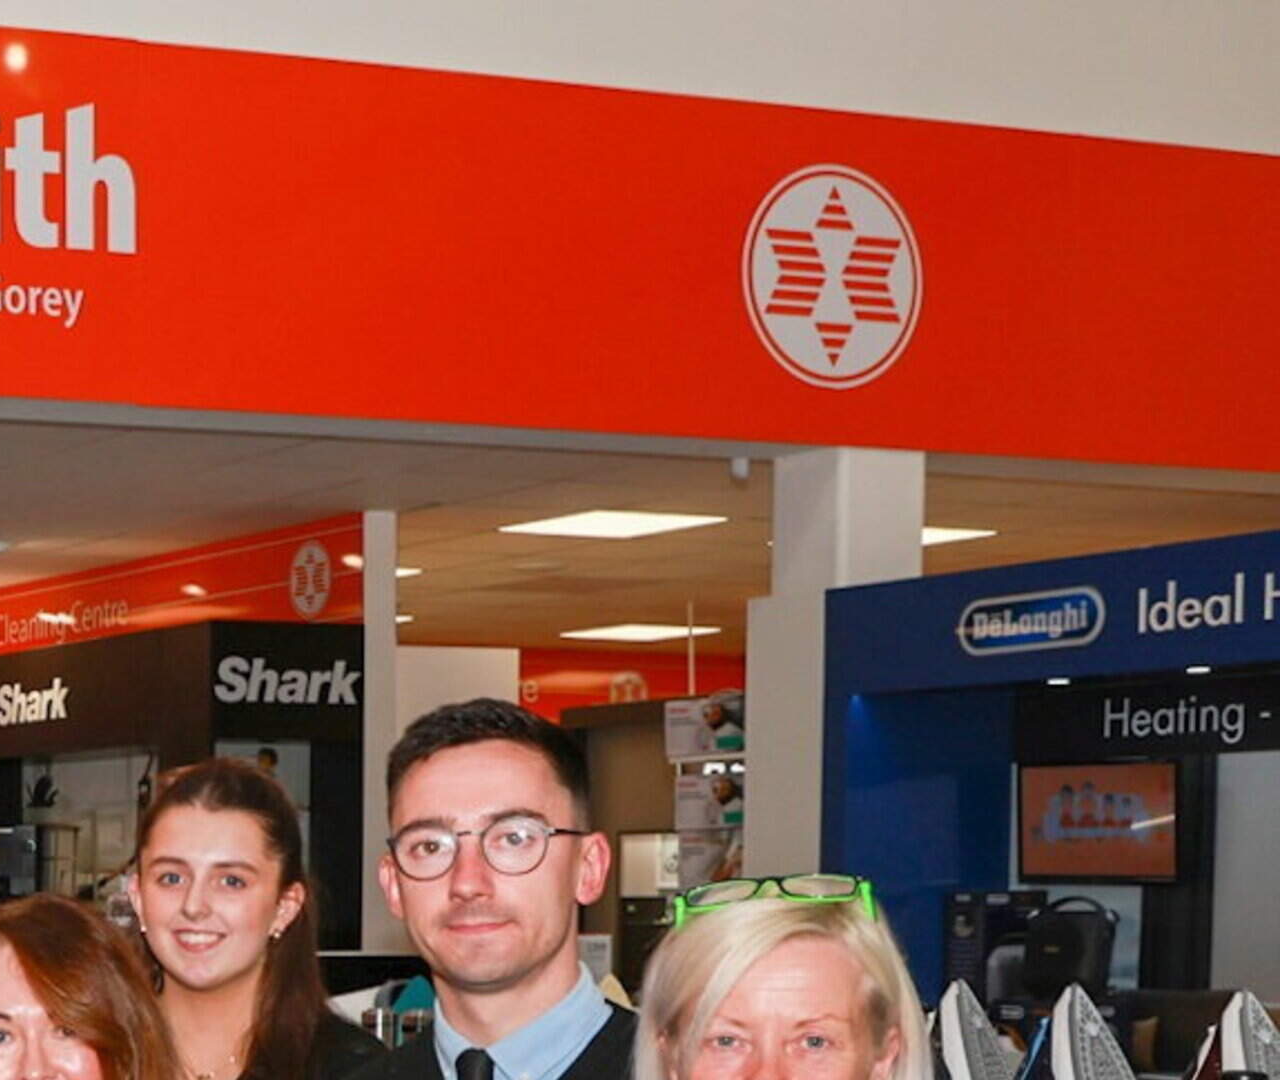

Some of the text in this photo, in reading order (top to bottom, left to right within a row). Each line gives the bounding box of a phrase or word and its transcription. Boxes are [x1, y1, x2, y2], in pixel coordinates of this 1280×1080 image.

[69, 599, 129, 634] Centre
[1137, 572, 1245, 634] Ideal
[213, 655, 363, 706] Shark
[1103, 695, 1245, 744] Heating
